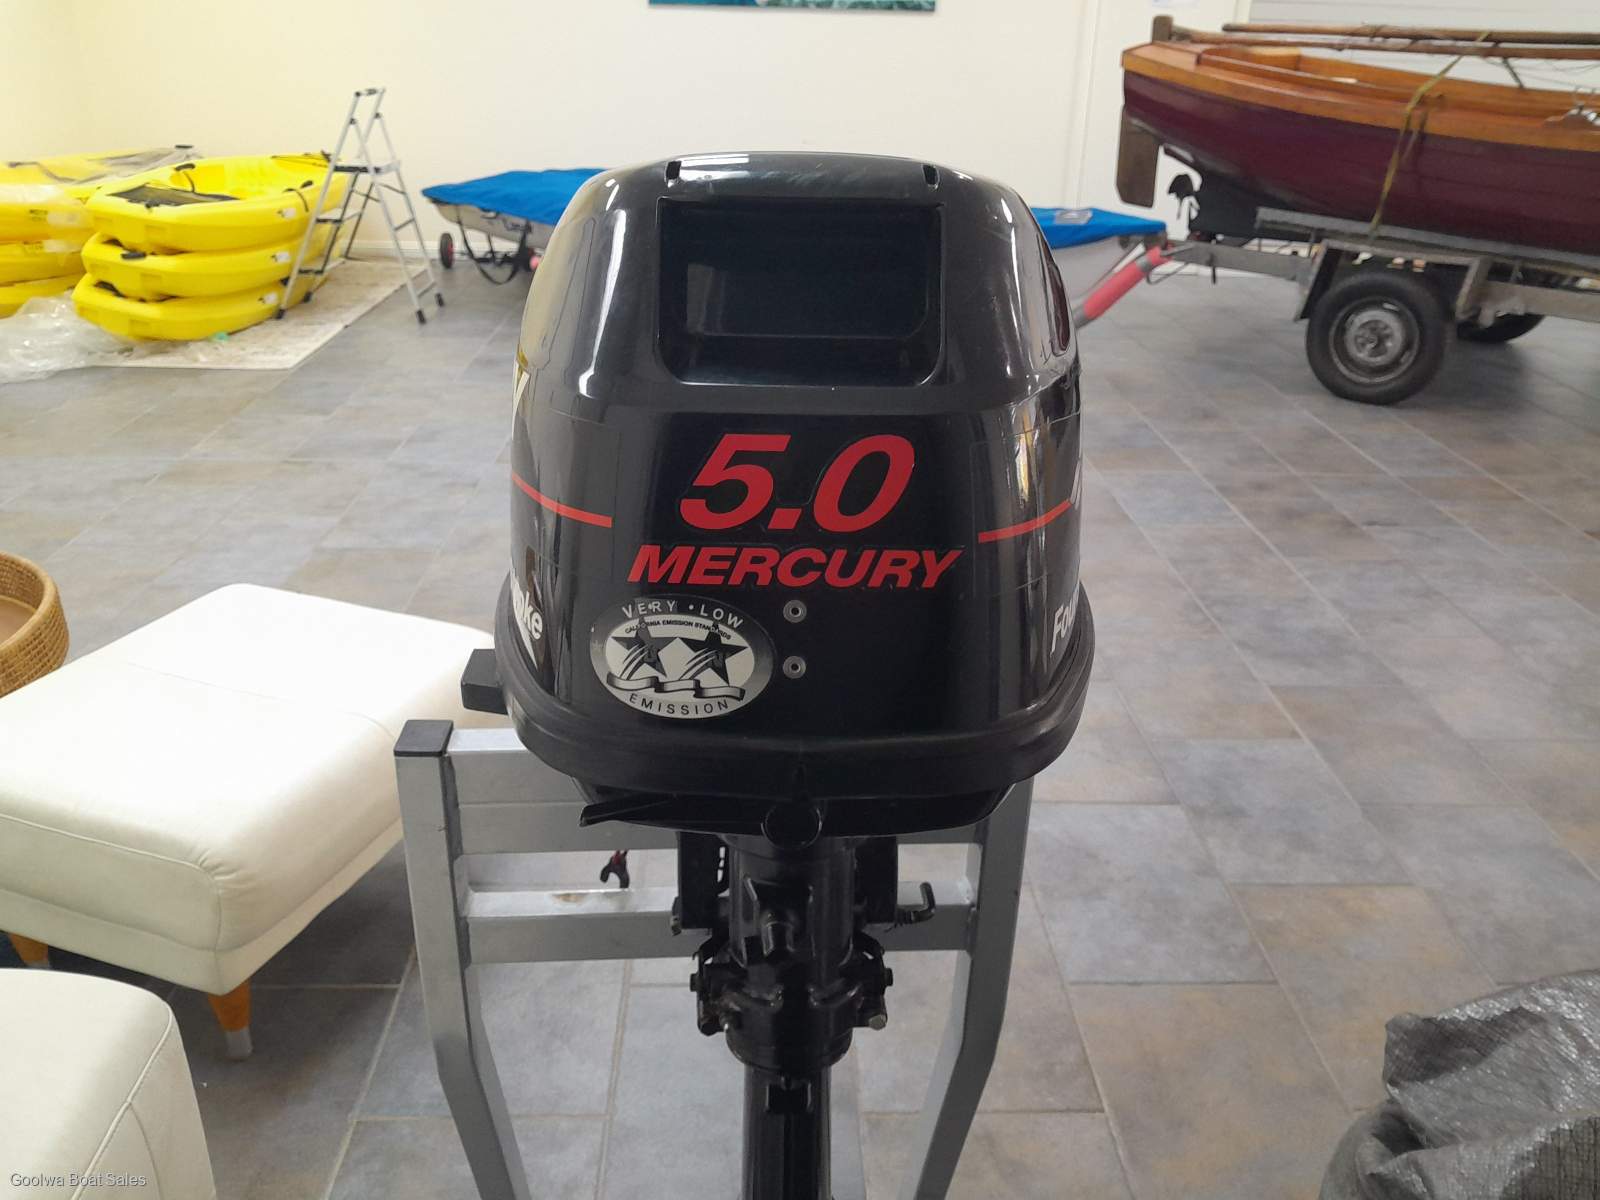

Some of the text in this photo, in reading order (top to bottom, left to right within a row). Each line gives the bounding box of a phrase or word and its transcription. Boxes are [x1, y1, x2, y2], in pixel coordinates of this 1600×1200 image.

[679, 433, 915, 532] 5.0
[627, 544, 965, 588] MERCURY
[621, 600, 744, 629] VERY LOW
[661, 619, 693, 627] EMISSION
[628, 692, 729, 716] EMISSION
